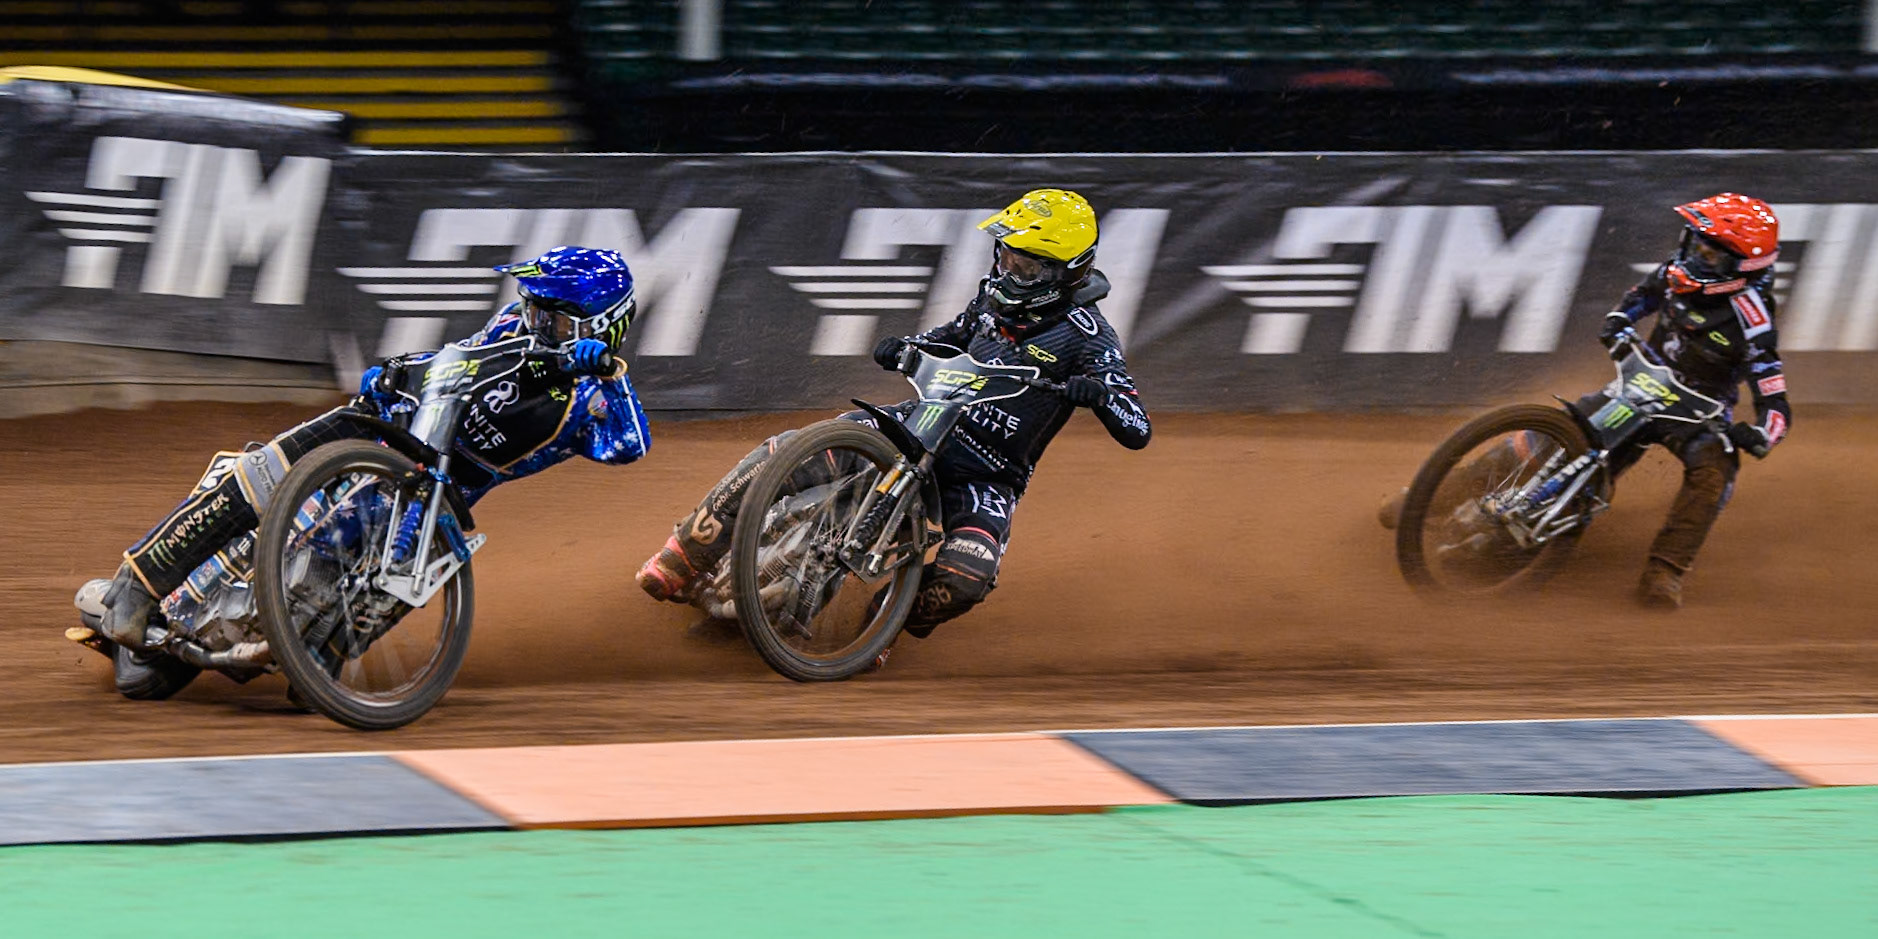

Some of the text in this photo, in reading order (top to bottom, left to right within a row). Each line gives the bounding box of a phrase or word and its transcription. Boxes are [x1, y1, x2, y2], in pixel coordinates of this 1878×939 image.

[26, 136, 333, 305] FIM
[1203, 205, 1603, 354] FIM
[930, 368, 979, 387] SGP
[1026, 343, 1058, 364] SGP
[166, 492, 230, 549] MONSTER
